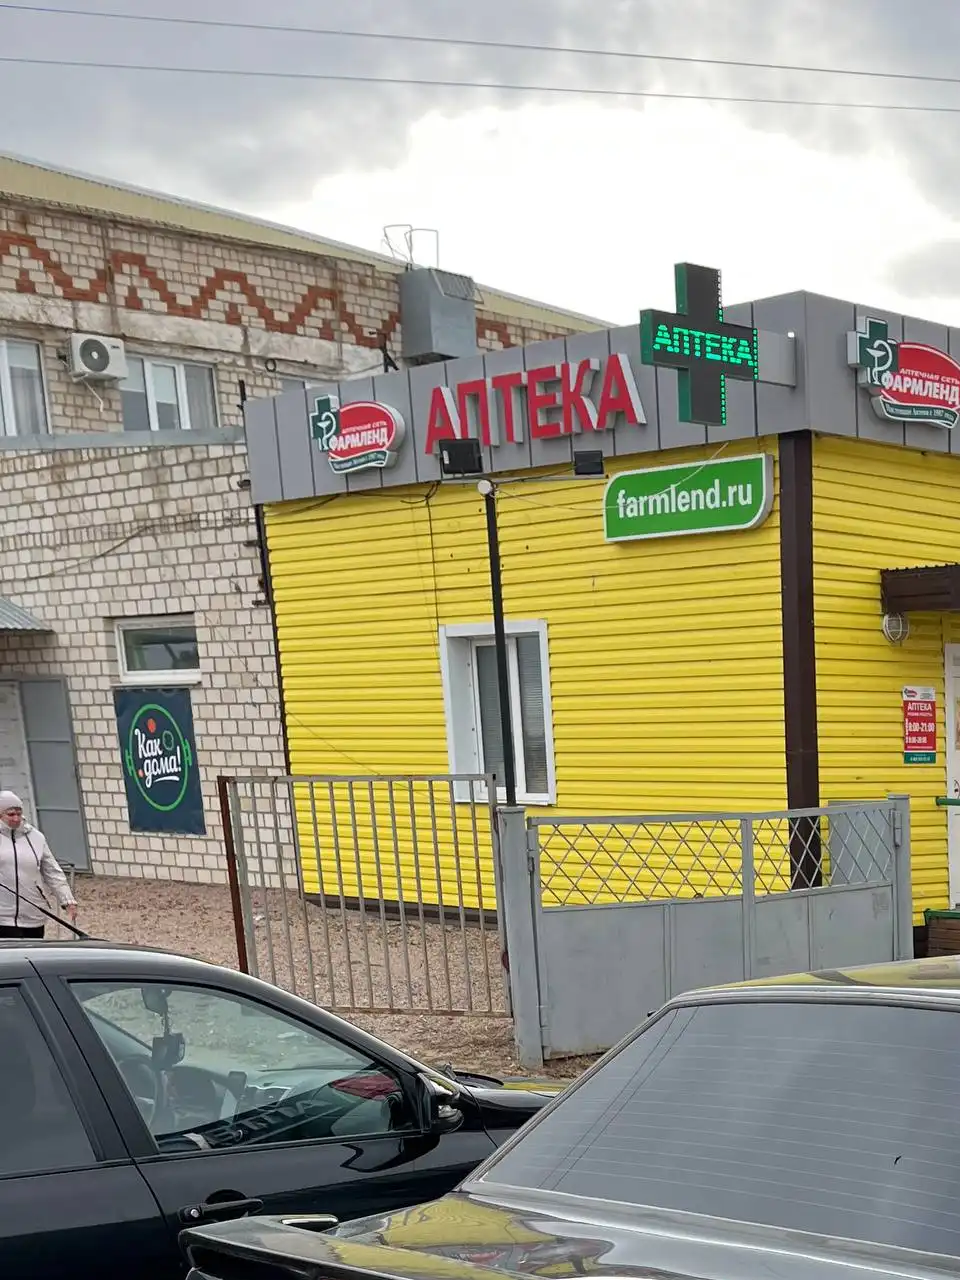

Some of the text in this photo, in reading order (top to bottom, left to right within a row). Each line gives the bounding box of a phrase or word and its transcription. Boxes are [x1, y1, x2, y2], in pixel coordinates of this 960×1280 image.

[653, 325, 753, 367] АПТЕКА
[881, 370, 960, 406] ФАРМЛЕНД
[941, 375, 960, 386] СЕТЬ
[425, 352, 645, 455] АПТЕКА
[328, 427, 389, 451] ФАРМЛЕНД
[617, 478, 752, 519] farmlend.ru
[907, 702, 932, 711] АПТЕКА
[134, 728, 163, 759] Как
[143, 745, 181, 788] дома!
